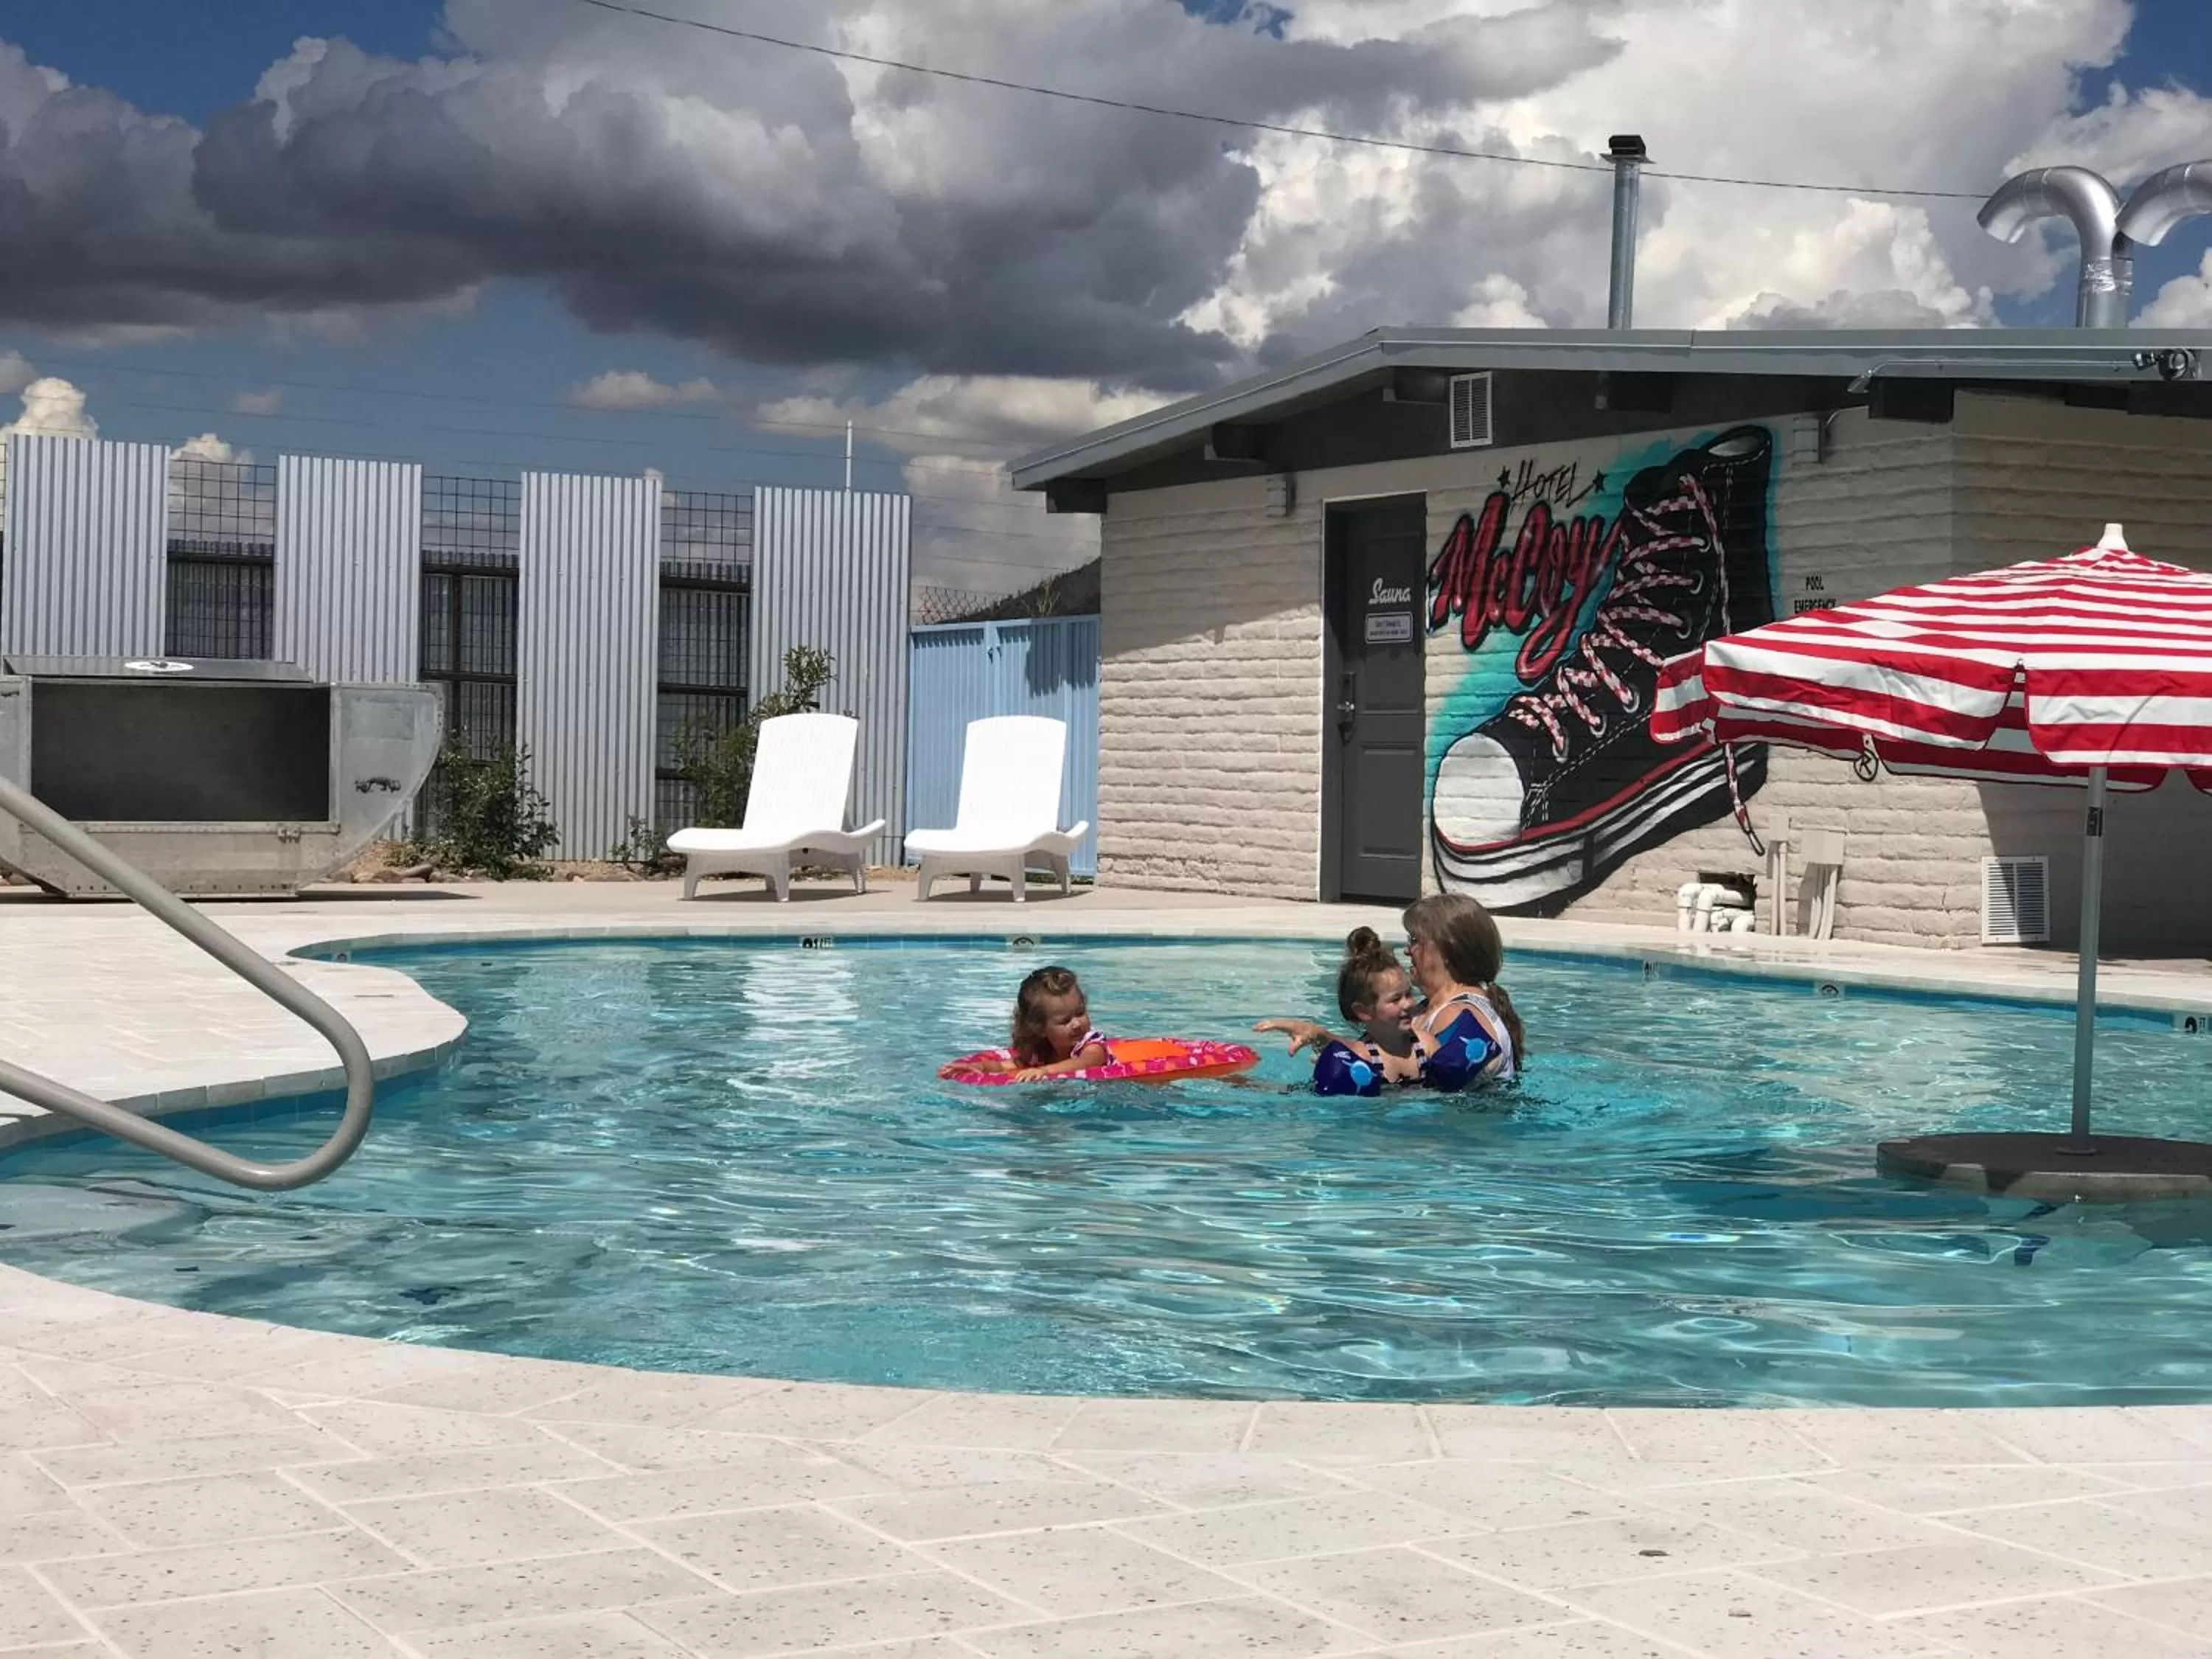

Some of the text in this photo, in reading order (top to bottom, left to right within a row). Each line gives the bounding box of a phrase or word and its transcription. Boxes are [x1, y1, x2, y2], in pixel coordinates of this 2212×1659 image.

[1512, 460, 1594, 508] HOTEL
[1368, 577, 1411, 605] Sauna
[1427, 491, 1623, 687] McCoy
[1805, 575, 1824, 591] POOL
[1793, 598, 1837, 614] EMERGENCY
